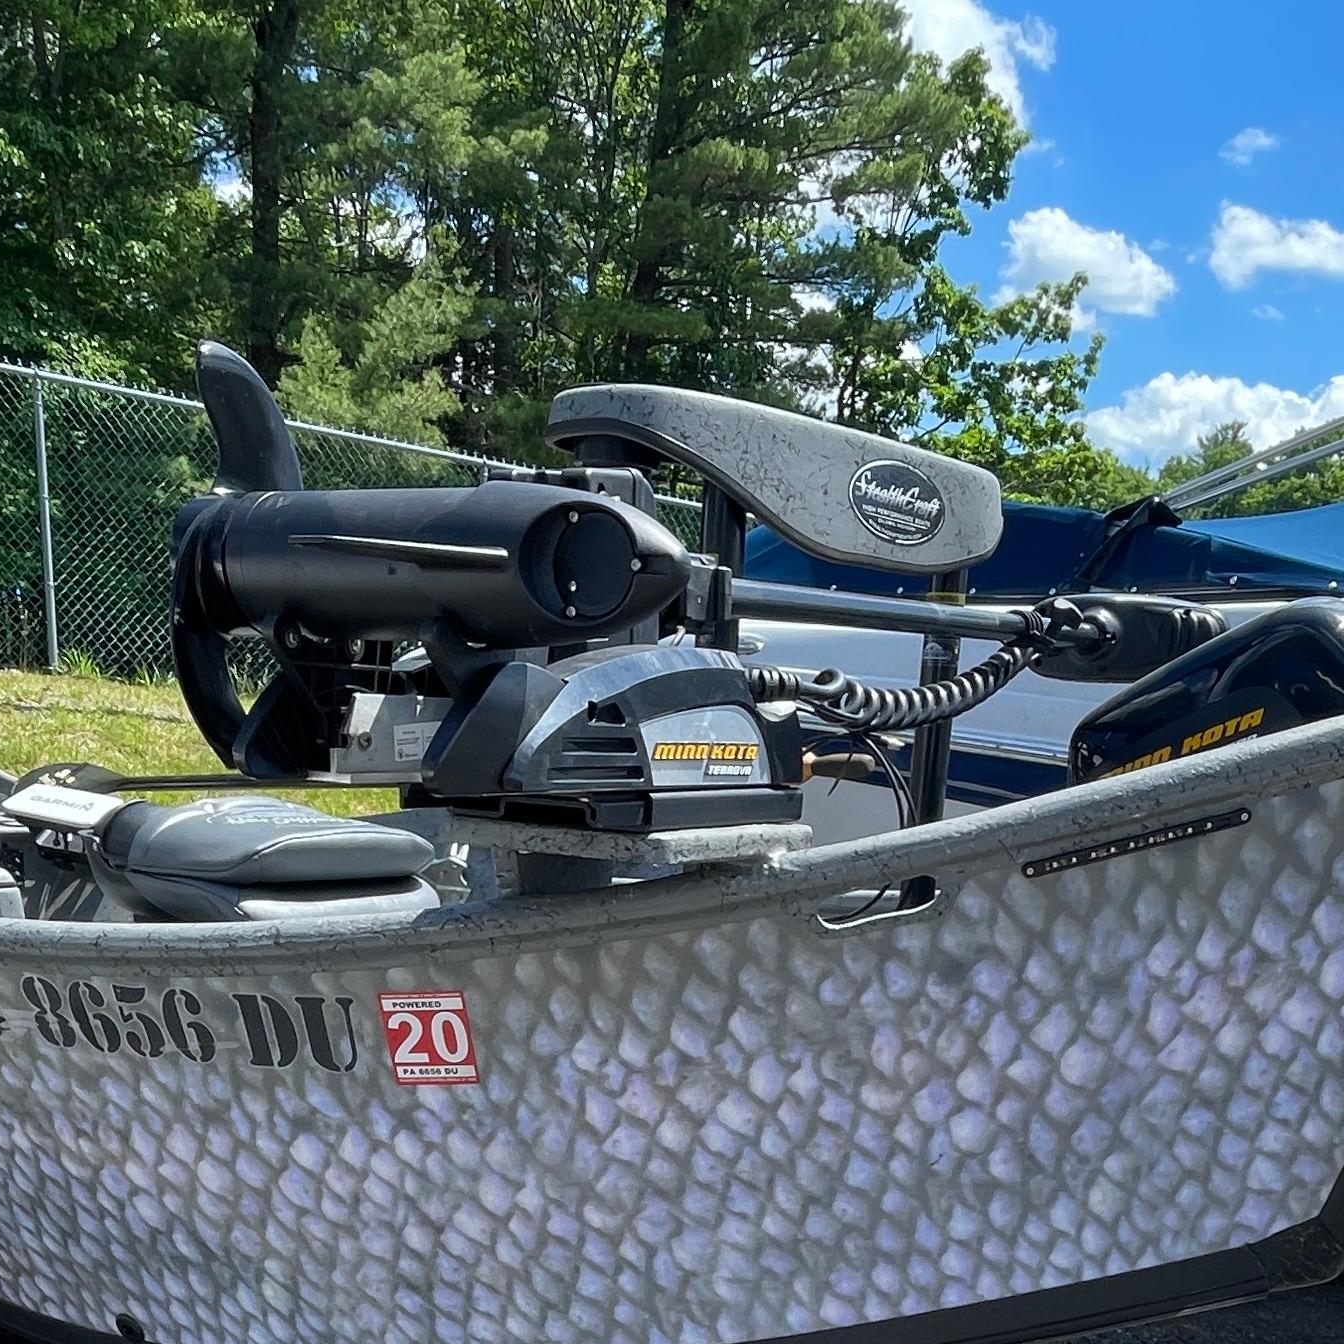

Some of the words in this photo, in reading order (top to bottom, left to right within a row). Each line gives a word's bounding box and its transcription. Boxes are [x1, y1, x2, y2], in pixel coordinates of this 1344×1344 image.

[855, 470, 941, 519] StealthCraft
[1099, 747, 1172, 779] INN
[1181, 707, 1265, 755] KOTA
[654, 744, 709, 760] MINN
[710, 744, 759, 760] KOTA
[707, 764, 753, 776] TERROVA
[30, 795, 94, 812] GARMIN
[392, 1000, 441, 1009] POWERED
[21, 975, 217, 1063] 8656
[231, 993, 355, 1072] DU
[387, 1011, 469, 1063] 20
[444, 1067, 458, 1075] DU
